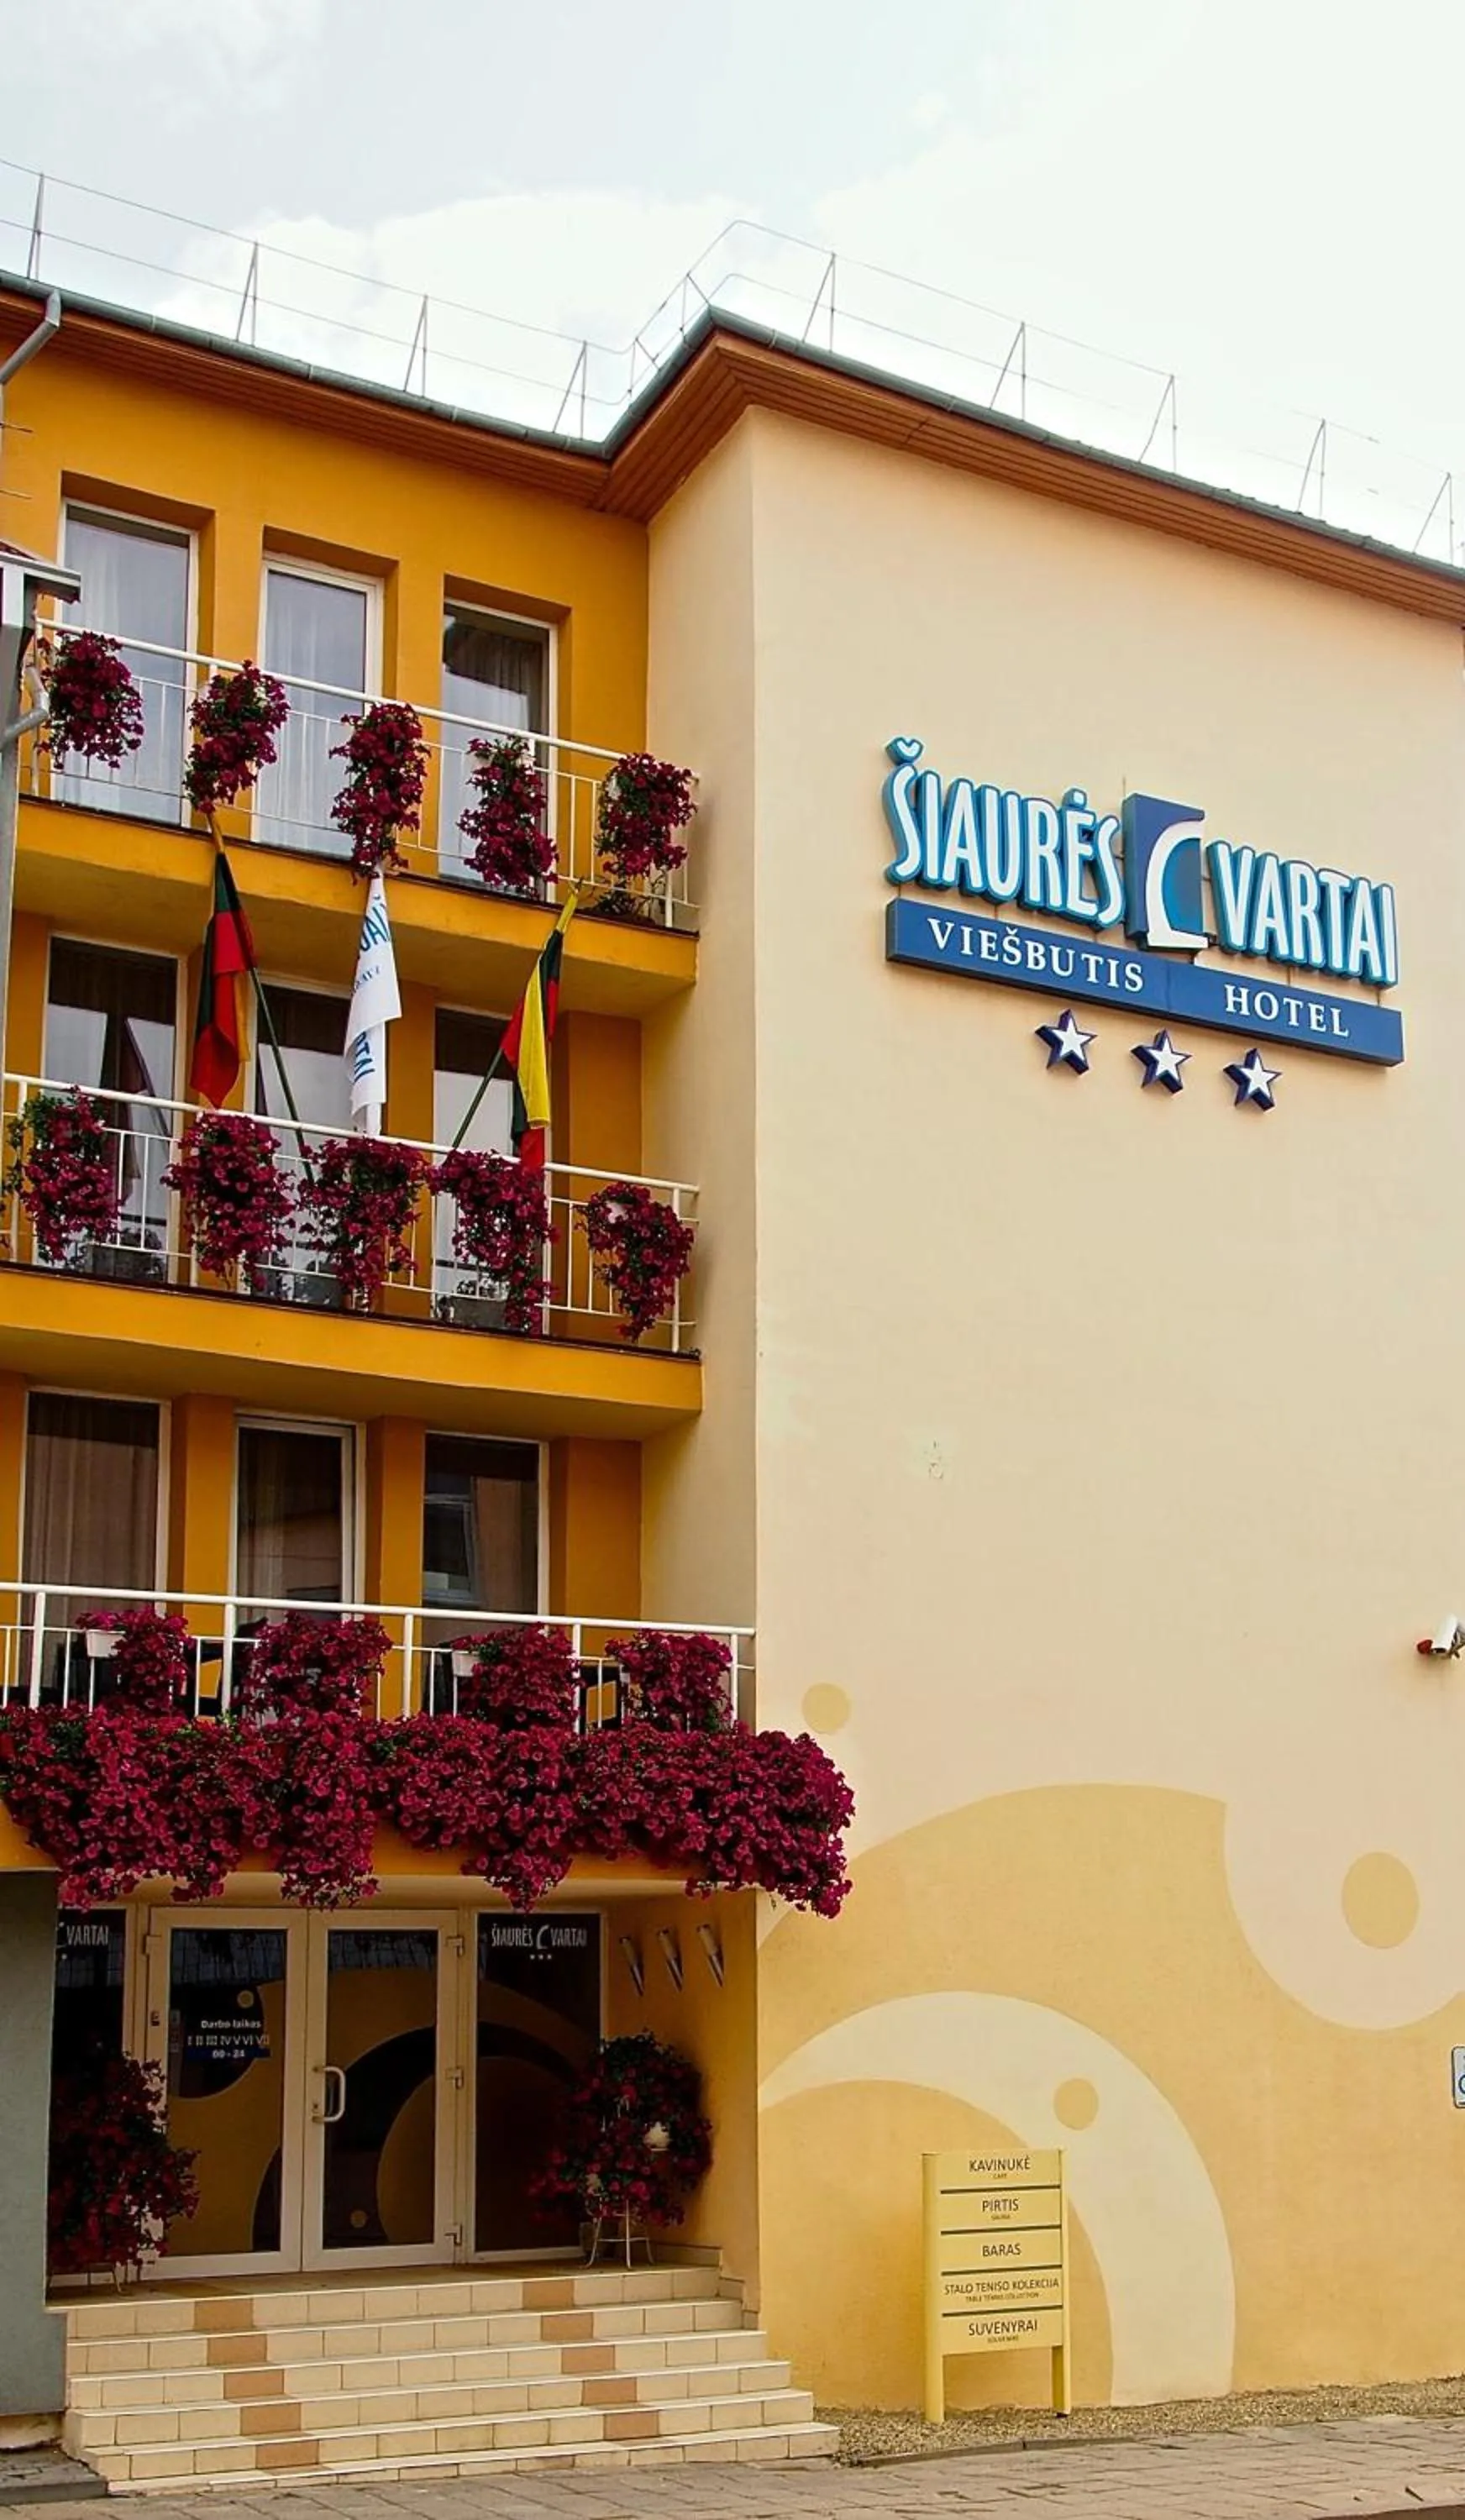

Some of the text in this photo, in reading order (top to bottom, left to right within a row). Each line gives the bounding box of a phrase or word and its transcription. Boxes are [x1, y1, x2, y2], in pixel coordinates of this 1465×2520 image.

[884, 737, 1125, 931] ŠIAURĖS
[1206, 841, 1399, 987] VARTAI
[927, 917, 1350, 1037] VIEŠBUTIS HOTEL
[66, 1924, 109, 1946] VARTAI
[550, 1928, 588, 1946] VARTAI
[969, 2156, 1032, 2171] KAVINUKĖ
[982, 2198, 1020, 2212] PIRTIS
[982, 2243, 1022, 2257] BARAS
[944, 2277, 1059, 2296] STALO TENISO KOLEKCIJA
[969, 2318, 1037, 2336] SUVENYRAI
